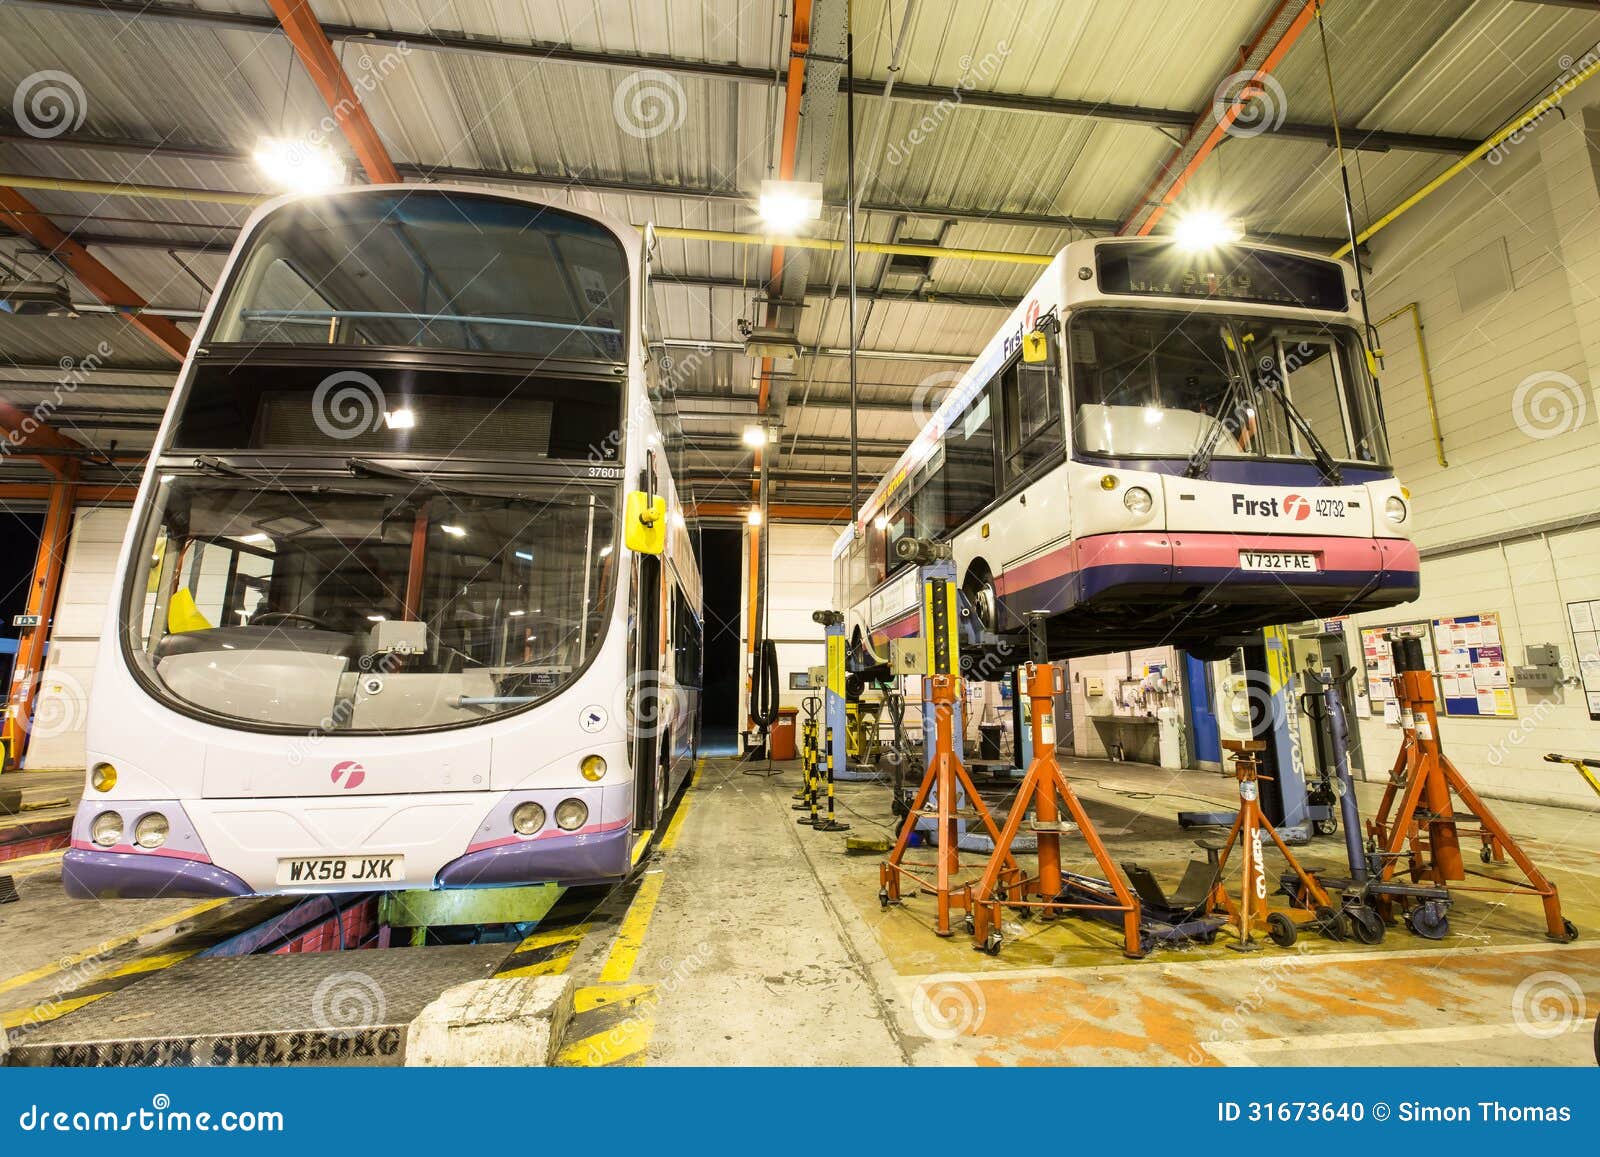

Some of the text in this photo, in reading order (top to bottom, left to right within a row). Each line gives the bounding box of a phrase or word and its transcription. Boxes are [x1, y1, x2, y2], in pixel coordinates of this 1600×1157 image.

[1003, 321, 1024, 361] First
[588, 467, 620, 478] 37601
[1231, 493, 1345, 518] First 42732
[1245, 553, 1311, 569] V732 FAE
[290, 859, 394, 881] WX58 JXK
